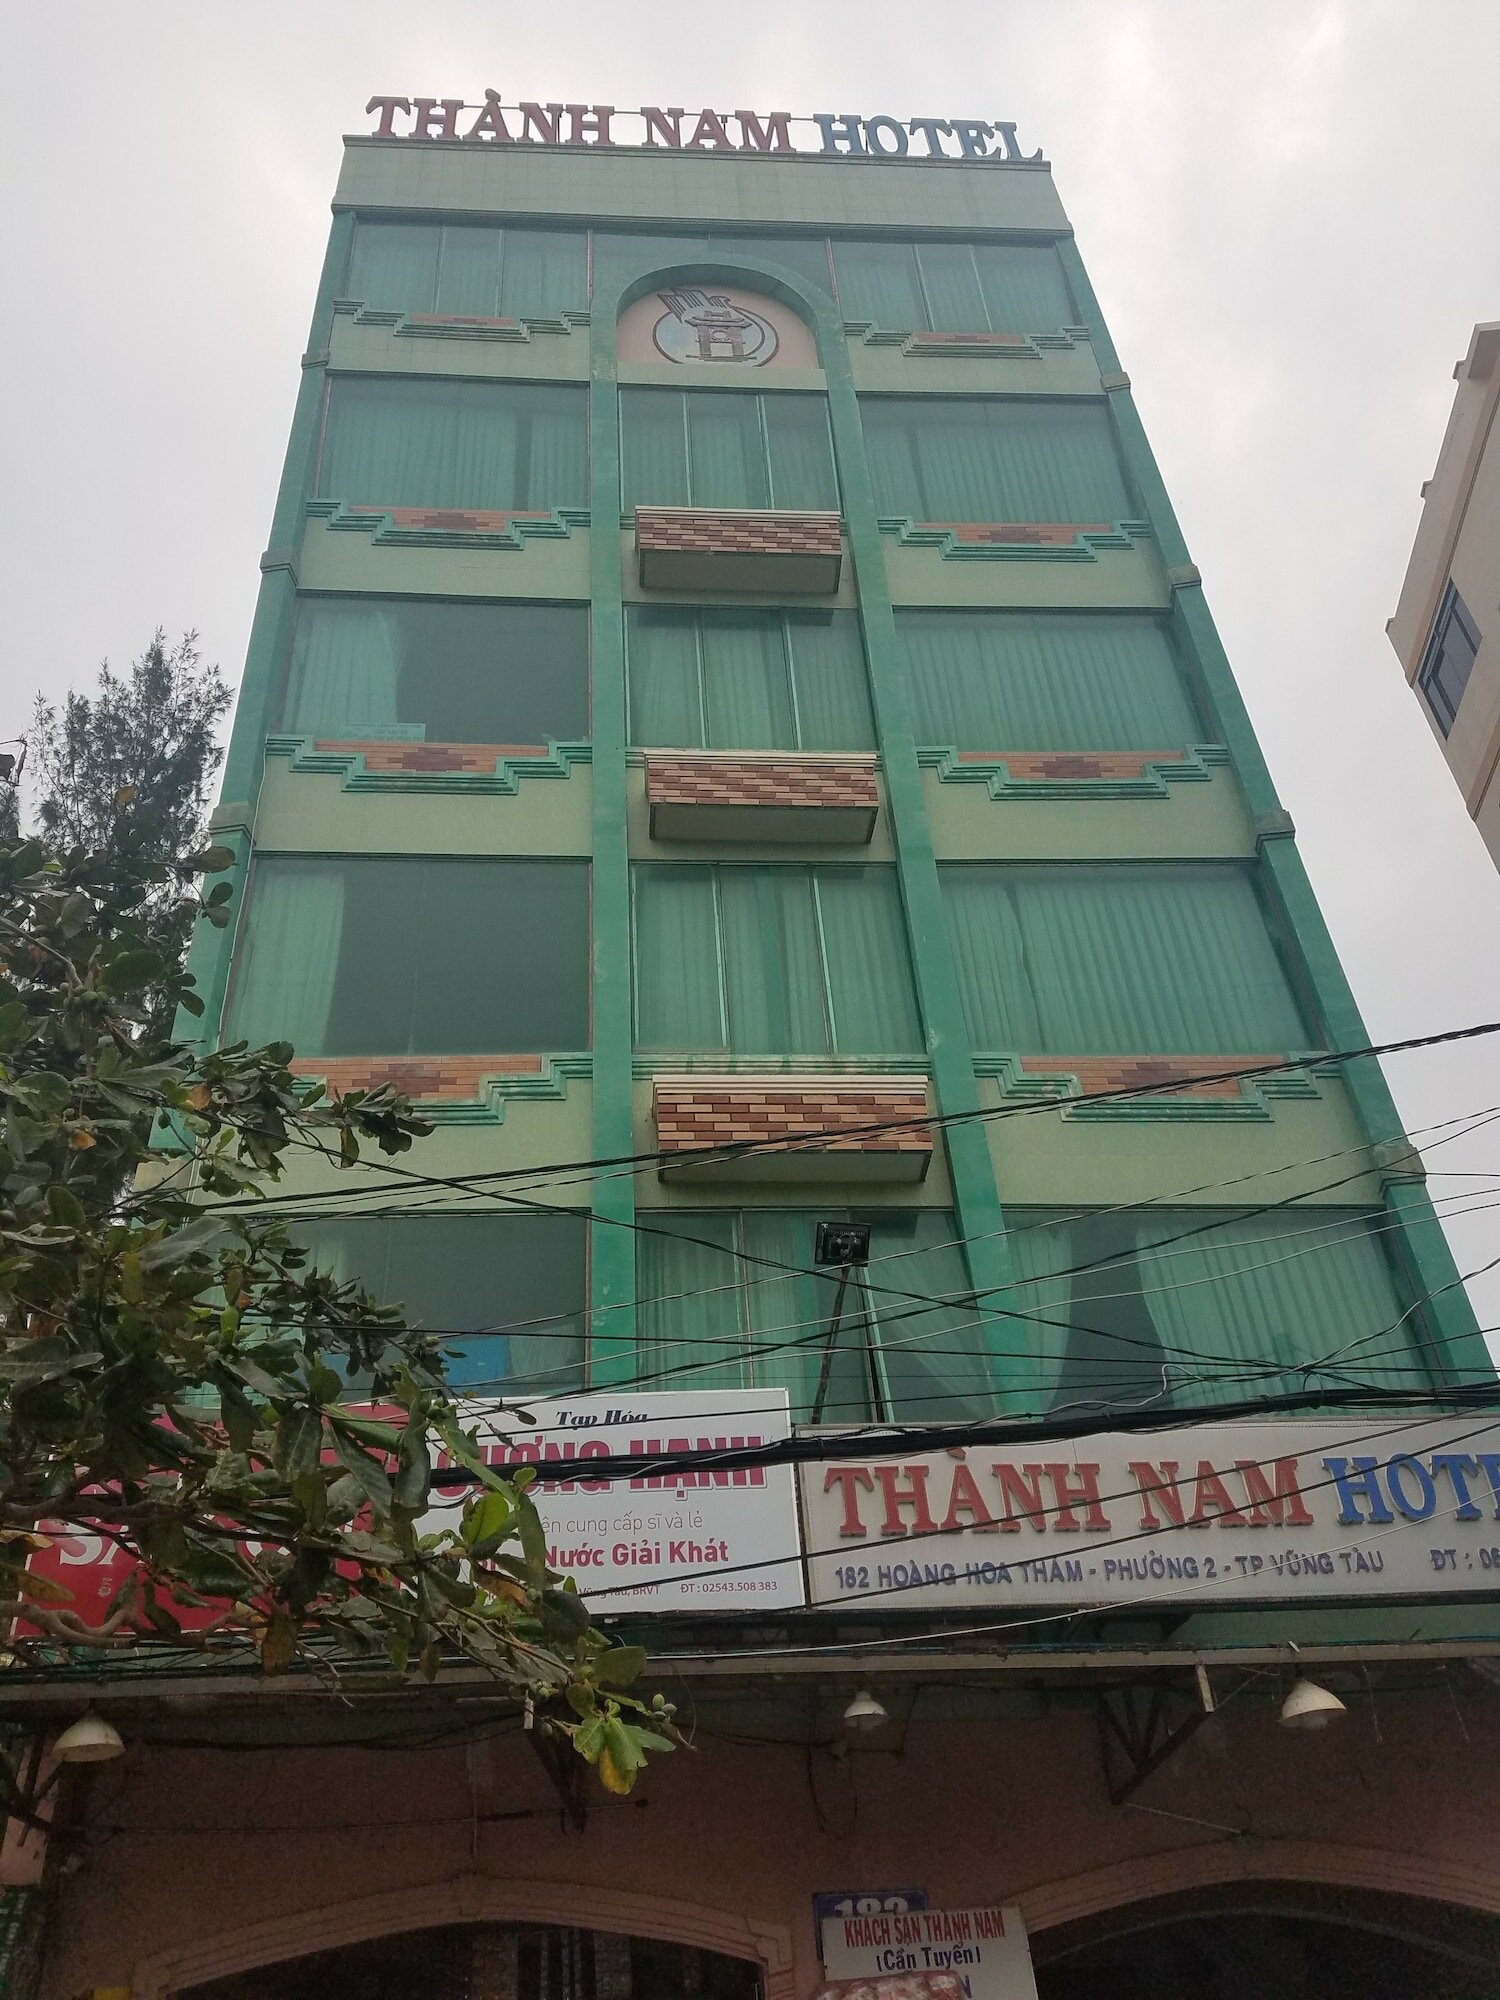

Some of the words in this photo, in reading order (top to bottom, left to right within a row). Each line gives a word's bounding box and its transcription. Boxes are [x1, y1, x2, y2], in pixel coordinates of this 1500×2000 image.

[365, 88, 614, 147] THÀNH
[640, 106, 797, 153] NAM
[813, 113, 1043, 162] HOTEL
[823, 1446, 1112, 1537] THÀNH
[1128, 1458, 1314, 1529] NAM
[566, 1518, 607, 1537] cung
[613, 1510, 643, 1535] cấp
[664, 1511, 683, 1529] và
[688, 1510, 703, 1528] lẻ
[544, 1542, 605, 1568] Nước
[611, 1540, 662, 1566] Giải
[669, 1538, 729, 1564] Khát
[835, 1566, 870, 1589] 182
[878, 1559, 957, 1588] HOÀNG
[966, 1561, 1013, 1585] HOA
[1204, 1556, 1218, 1578] 2
[1235, 1555, 1264, 1576] TP
[1339, 1547, 1385, 1574] TÀU
[758, 1581, 778, 1591] 383
[974, 1910, 1006, 1939] NAM
